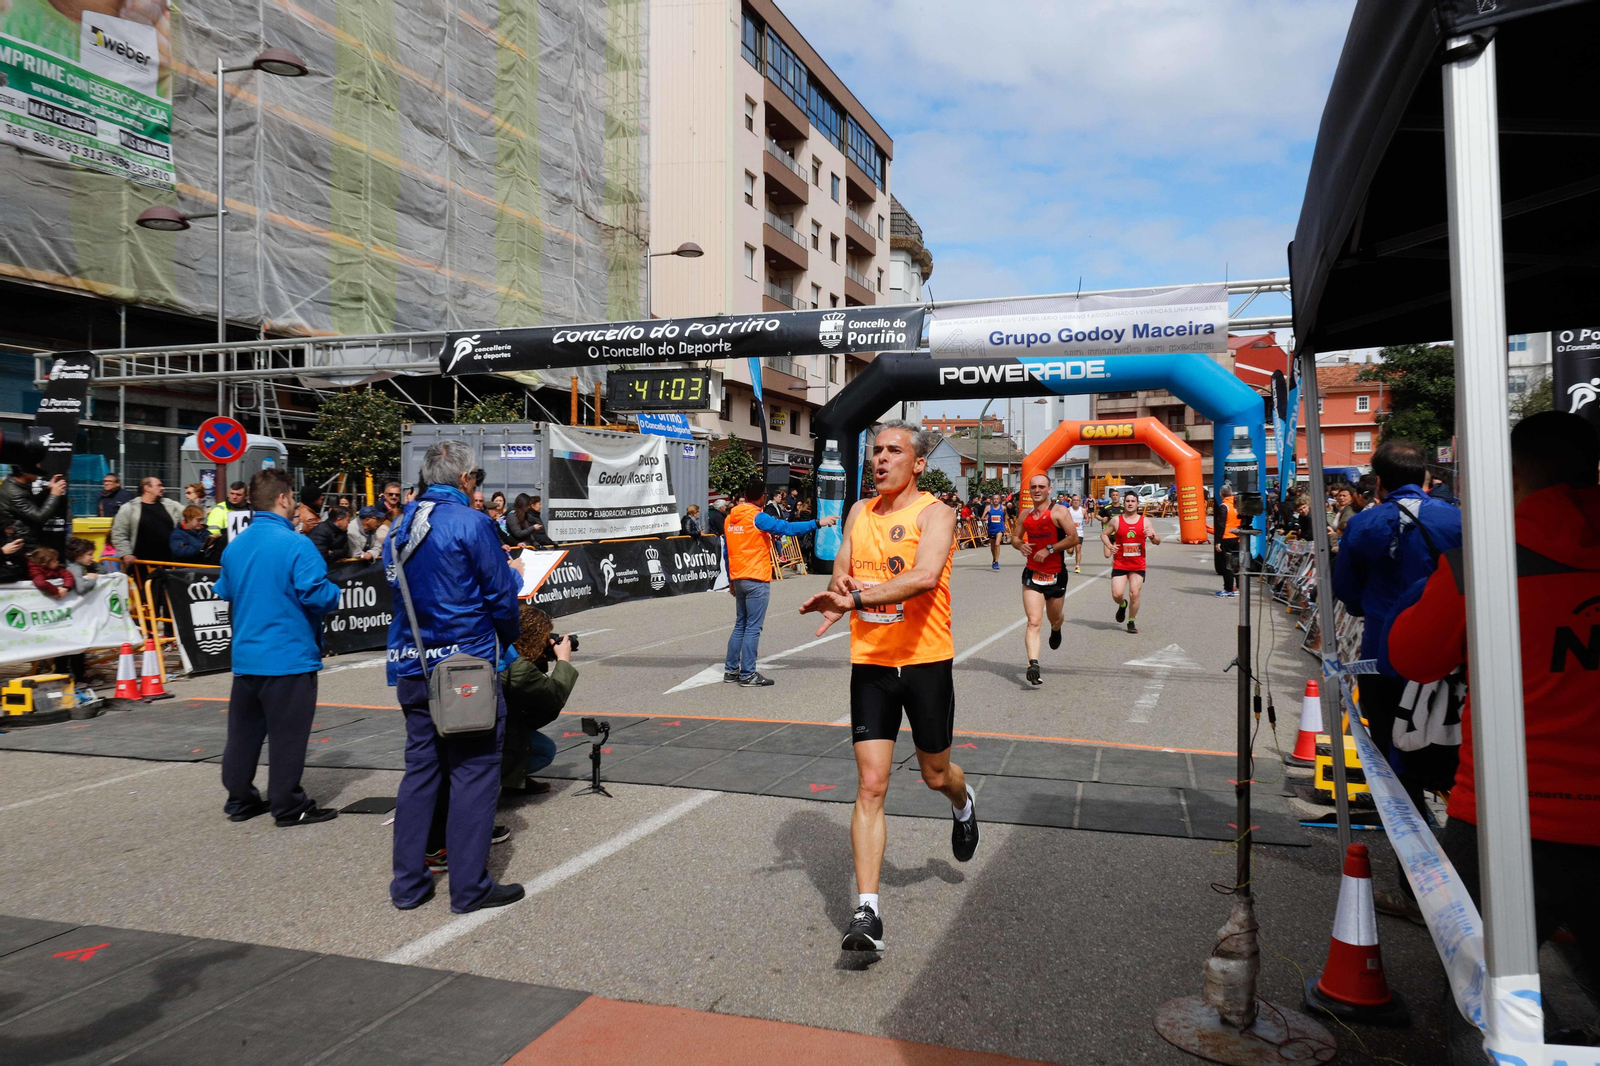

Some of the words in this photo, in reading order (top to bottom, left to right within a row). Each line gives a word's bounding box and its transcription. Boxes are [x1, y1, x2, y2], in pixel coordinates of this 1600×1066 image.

[103, 34, 151, 66] weber
[66, 73, 89, 93] CON
[89, 80, 169, 122] REPROGALICIA
[33, 131, 54, 147] 986
[57, 139, 79, 155] 293
[82, 147, 103, 162] 313
[111, 155, 130, 170] 986
[152, 169, 170, 182] 610
[1059, 312, 1086, 320] URBANO
[1090, 310, 1135, 319] ADOQUINADO
[1139, 307, 1173, 315] VIVENDAS
[649, 323, 680, 339] do
[684, 316, 781, 338] Porriño
[848, 318, 890, 329] Concello
[892, 318, 907, 329] do
[847, 329, 907, 345] Porriño
[988, 330, 1052, 348] Grupo
[1057, 326, 1126, 344] Godoy
[1132, 320, 1215, 339] Maceira
[1559, 330, 1574, 343] O
[587, 345, 600, 359] O
[602, 343, 655, 358] Concello
[658, 341, 675, 356] do
[678, 338, 732, 357] Deporte
[1145, 344, 1165, 353] en
[1169, 340, 1214, 353] pedra
[1556, 345, 1565, 353] O
[473, 353, 482, 361] de
[483, 352, 512, 361] deportes
[939, 359, 1106, 385] POWERADE
[645, 420, 666, 431] Concello
[1082, 423, 1133, 439] GADIS
[638, 454, 660, 468] Grupo
[598, 471, 627, 487] Godoy
[628, 471, 663, 484] Maceira
[554, 510, 588, 518] PROXECTOS
[674, 552, 683, 570] O
[682, 548, 717, 568] Porriño
[331, 615, 346, 632] do
[349, 611, 393, 633] Deporte
[400, 643, 460, 660] ABNCA
